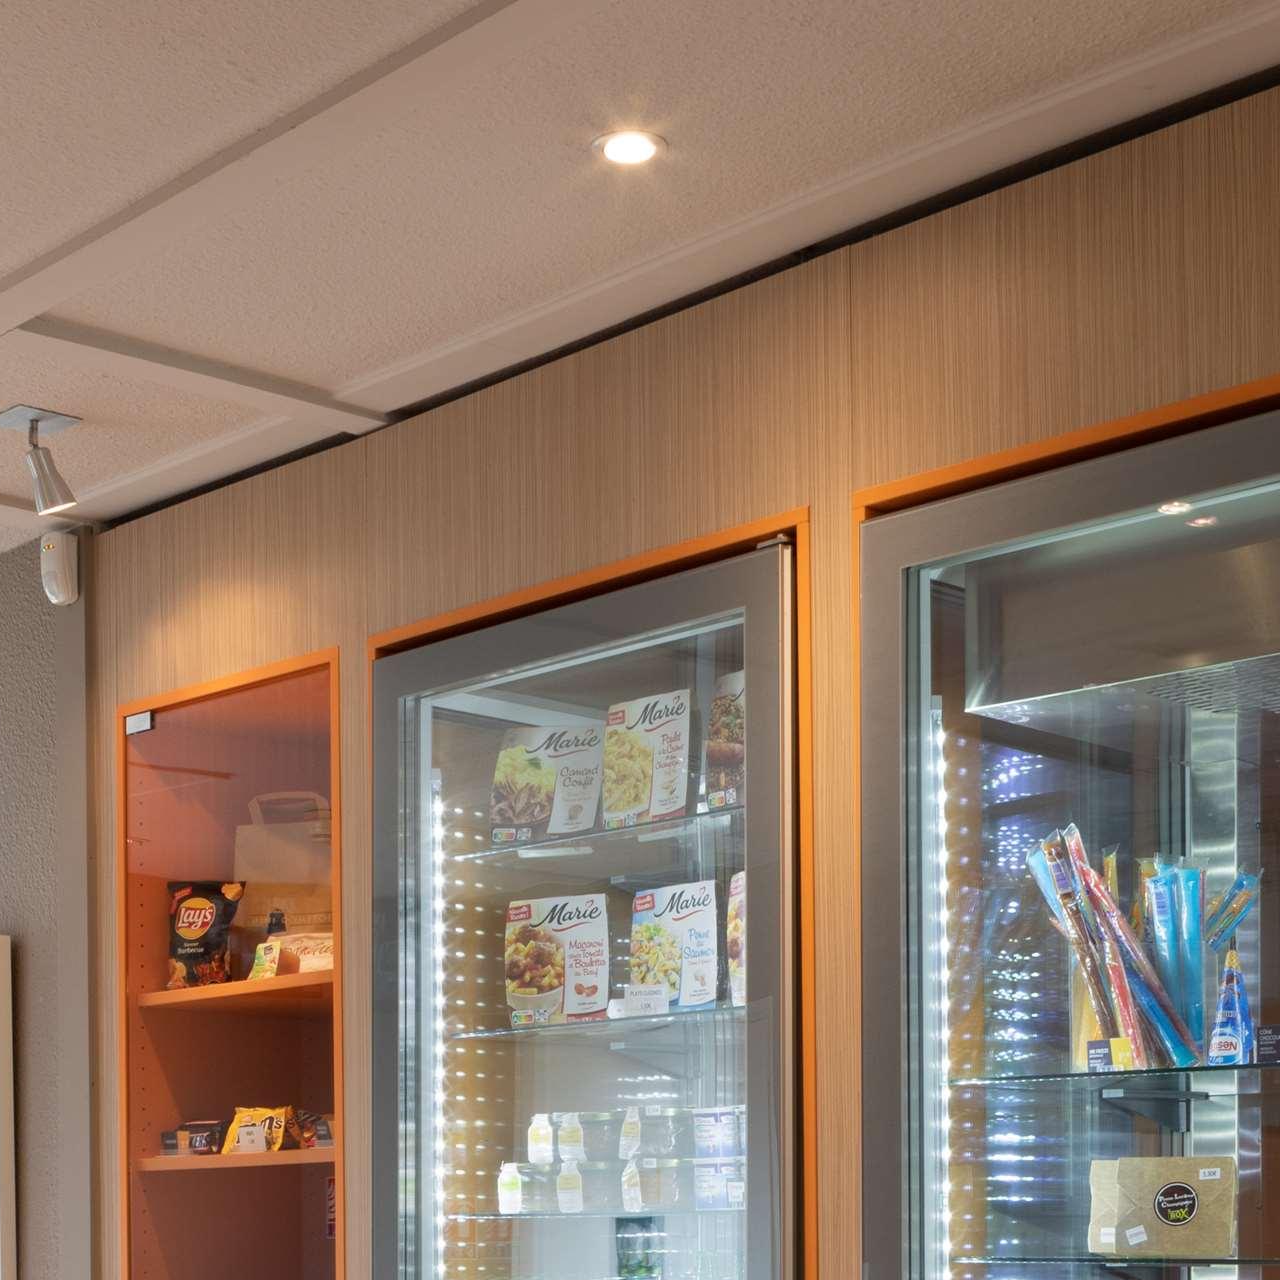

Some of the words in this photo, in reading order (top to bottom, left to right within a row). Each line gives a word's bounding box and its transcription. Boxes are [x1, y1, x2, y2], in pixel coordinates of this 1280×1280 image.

[626, 695, 687, 730] Marie
[525, 728, 601, 754] Marie
[528, 899, 602, 928] Marie
[654, 886, 713, 918] Marie
[177, 906, 214, 930] Lay's
